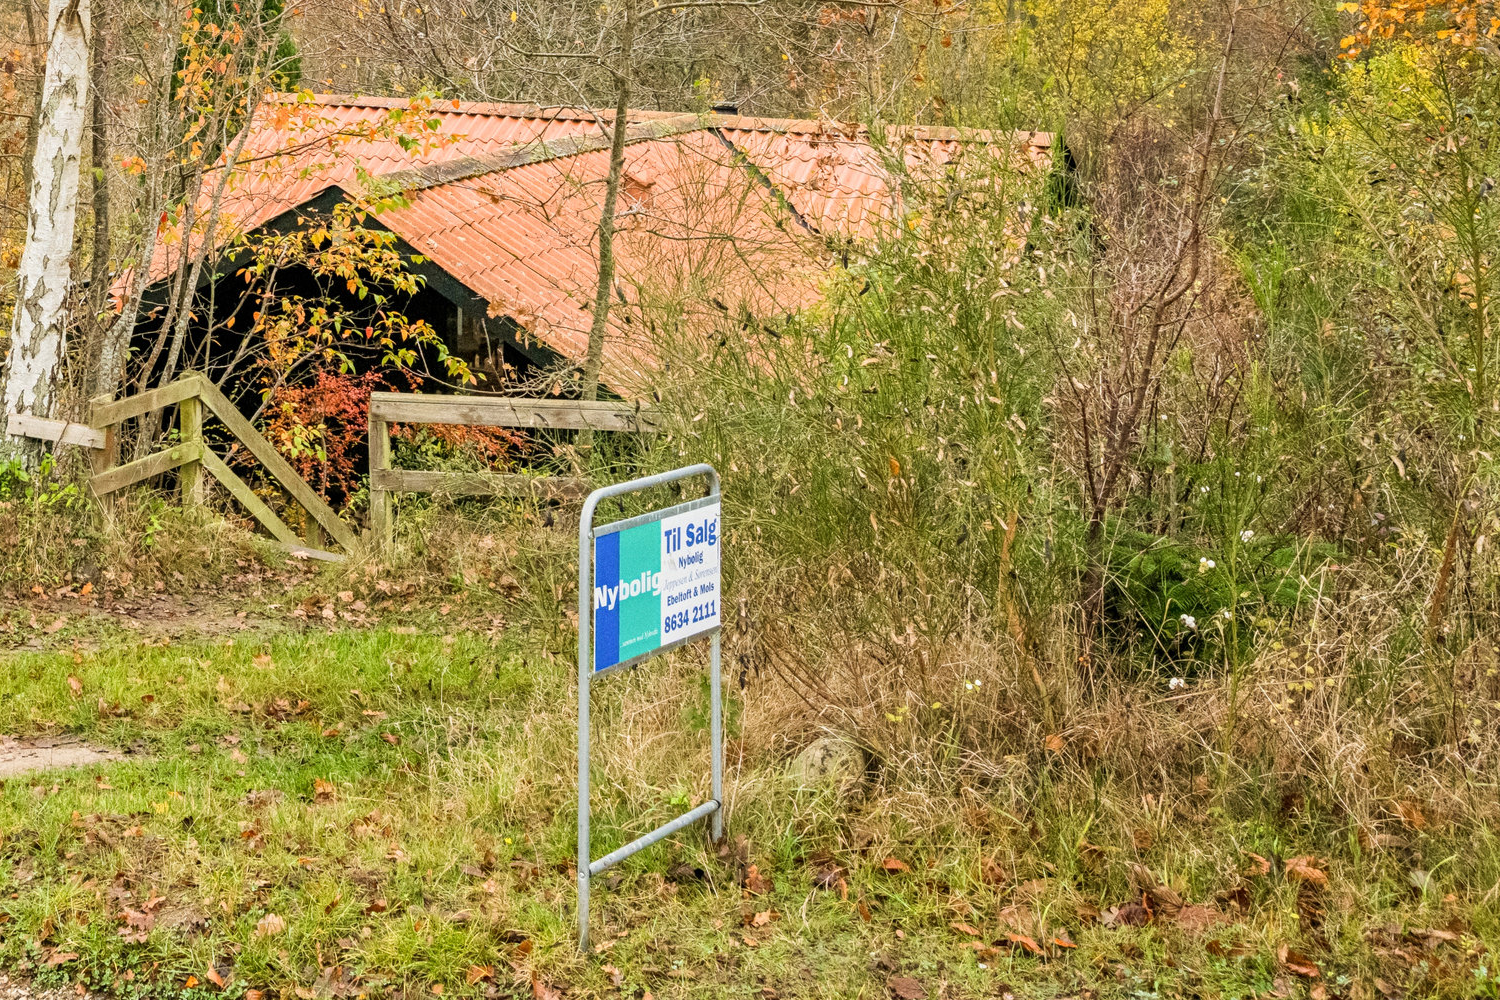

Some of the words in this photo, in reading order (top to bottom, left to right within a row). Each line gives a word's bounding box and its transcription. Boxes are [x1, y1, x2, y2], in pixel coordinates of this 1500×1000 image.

[664, 526, 681, 554] Til
[686, 518, 717, 547] Salg
[678, 550, 704, 569] Nybolig
[594, 570, 662, 611] Nybolig
[667, 588, 692, 606] Ebeltoft
[693, 586, 699, 598] &
[700, 582, 715, 595] Mols
[664, 609, 690, 634] 8634
[692, 599, 717, 623] 2111
